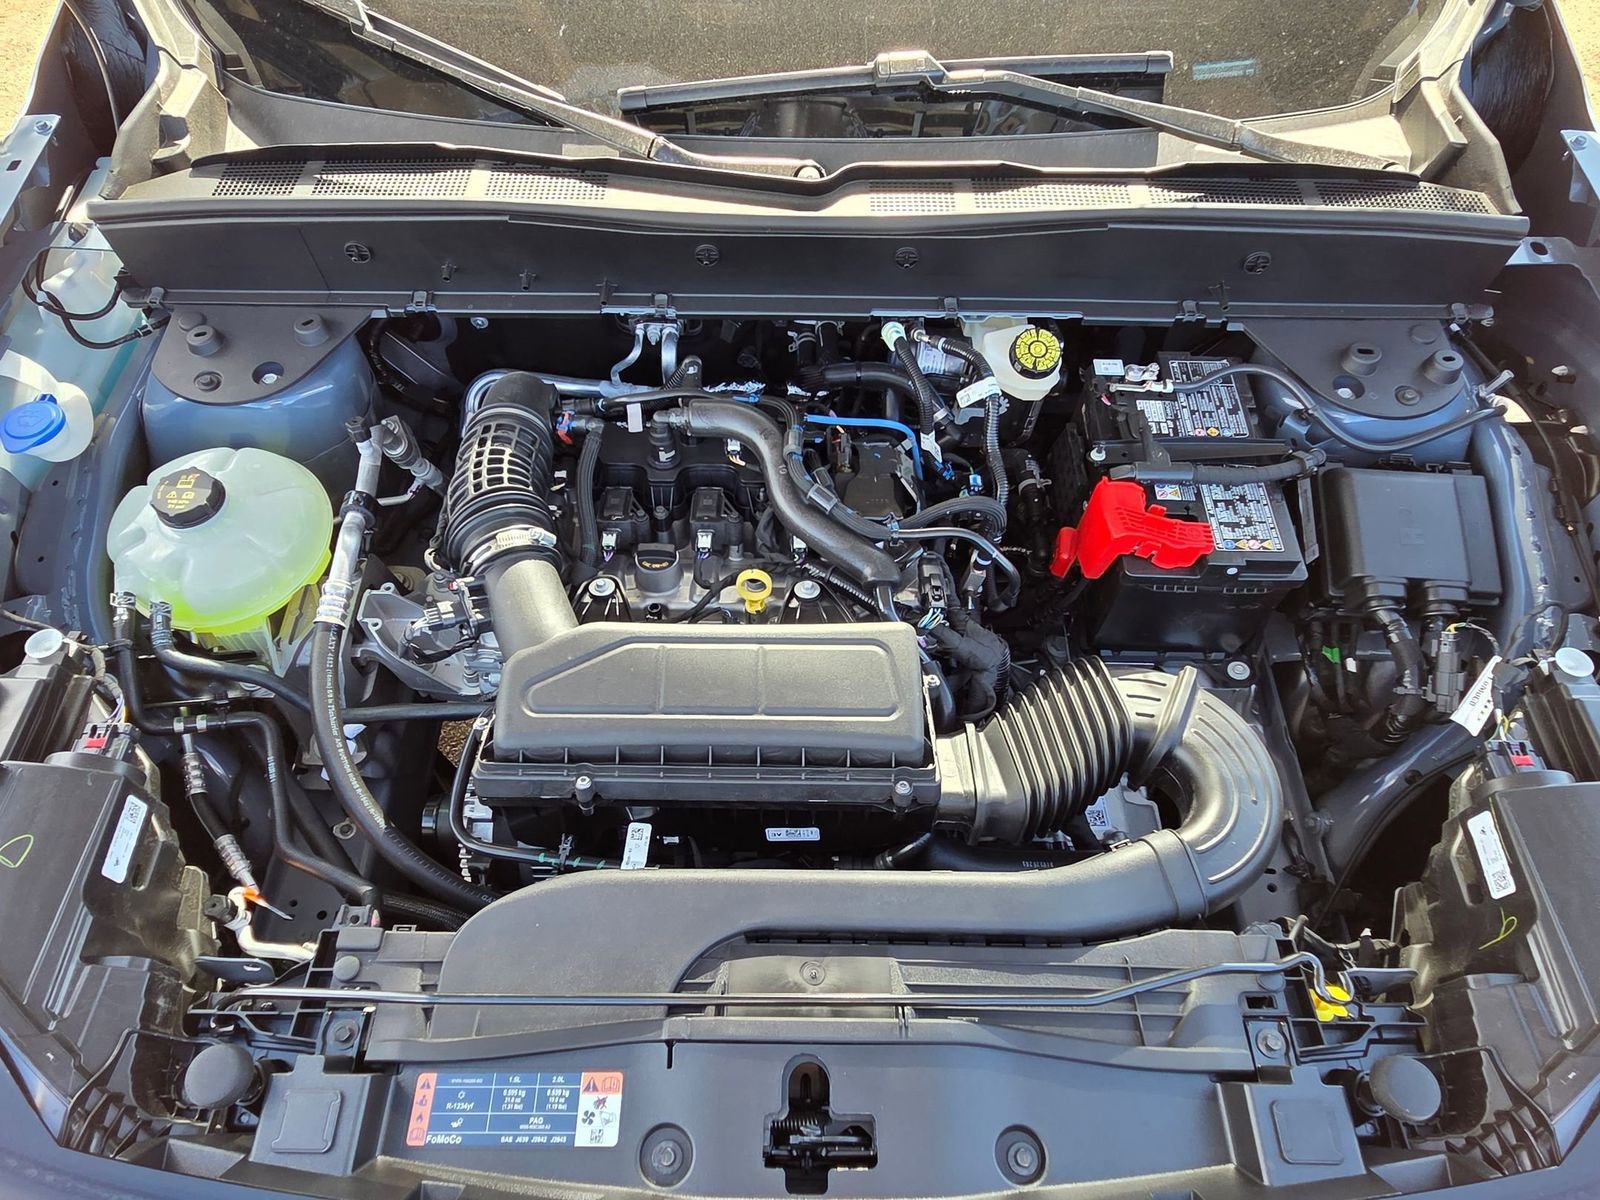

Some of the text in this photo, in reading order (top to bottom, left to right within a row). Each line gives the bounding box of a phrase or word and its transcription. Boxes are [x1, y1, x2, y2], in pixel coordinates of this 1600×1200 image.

[338, 748, 352, 774] SUCTION
[348, 772, 360, 789] HOSE
[445, 1102, 475, 1111] R-1234yf
[425, 1134, 462, 1145] FoMoCo
